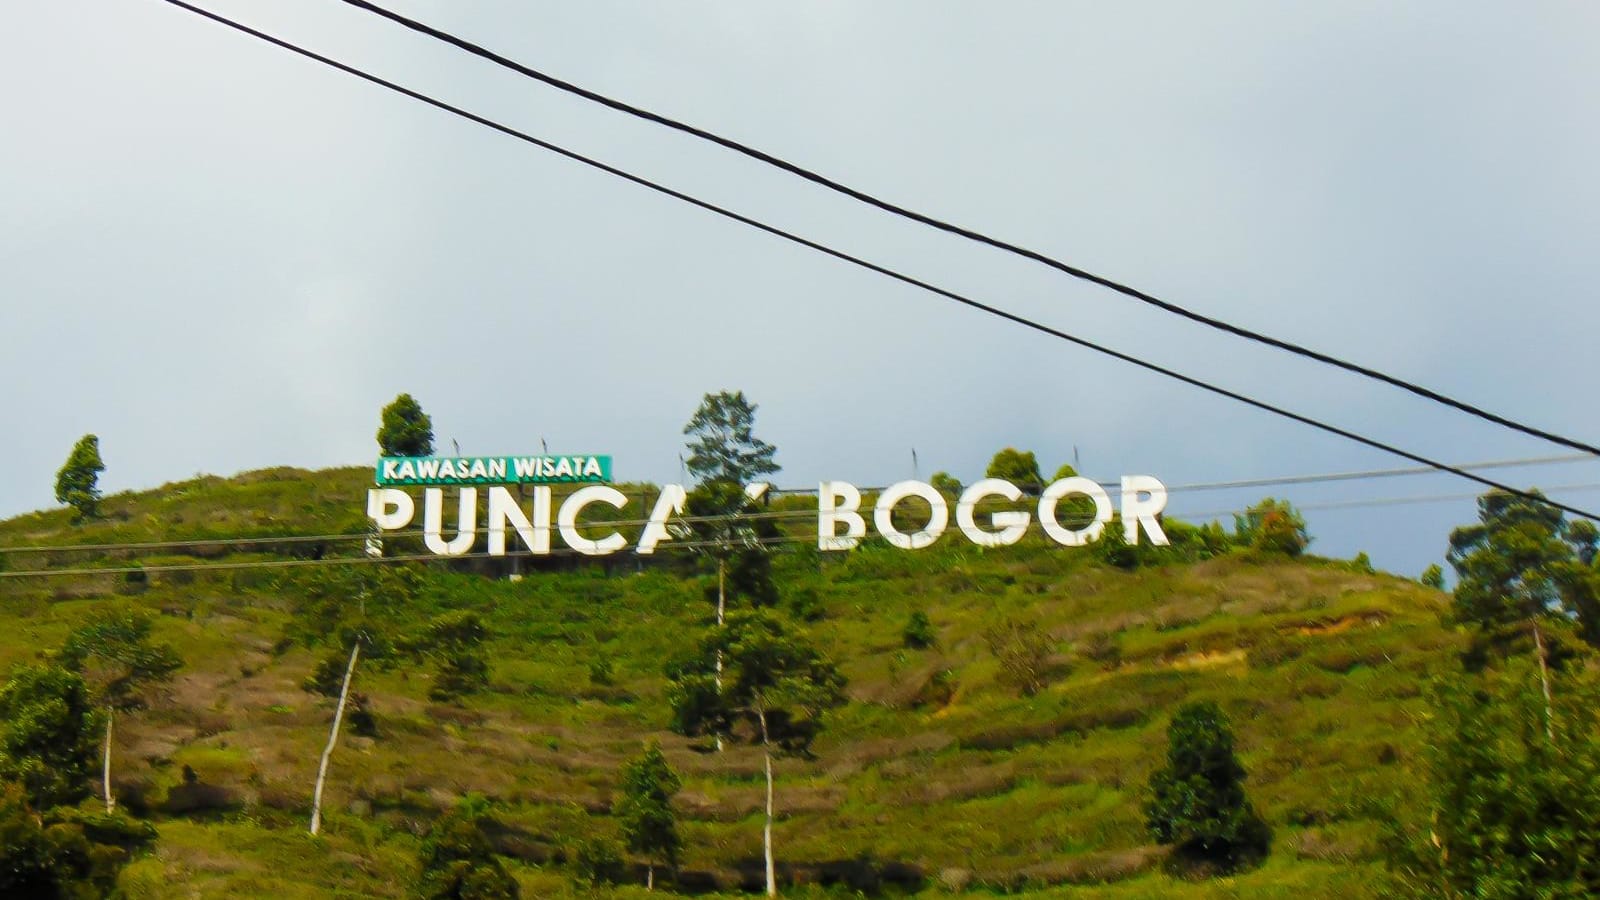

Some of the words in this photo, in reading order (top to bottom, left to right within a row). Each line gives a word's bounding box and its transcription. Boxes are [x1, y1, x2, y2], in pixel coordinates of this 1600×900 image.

[383, 457, 507, 480] KAWASAN
[513, 456, 603, 478] WISATA
[366, 482, 771, 557] PUNCA
[818, 475, 1171, 551] BOGOR
